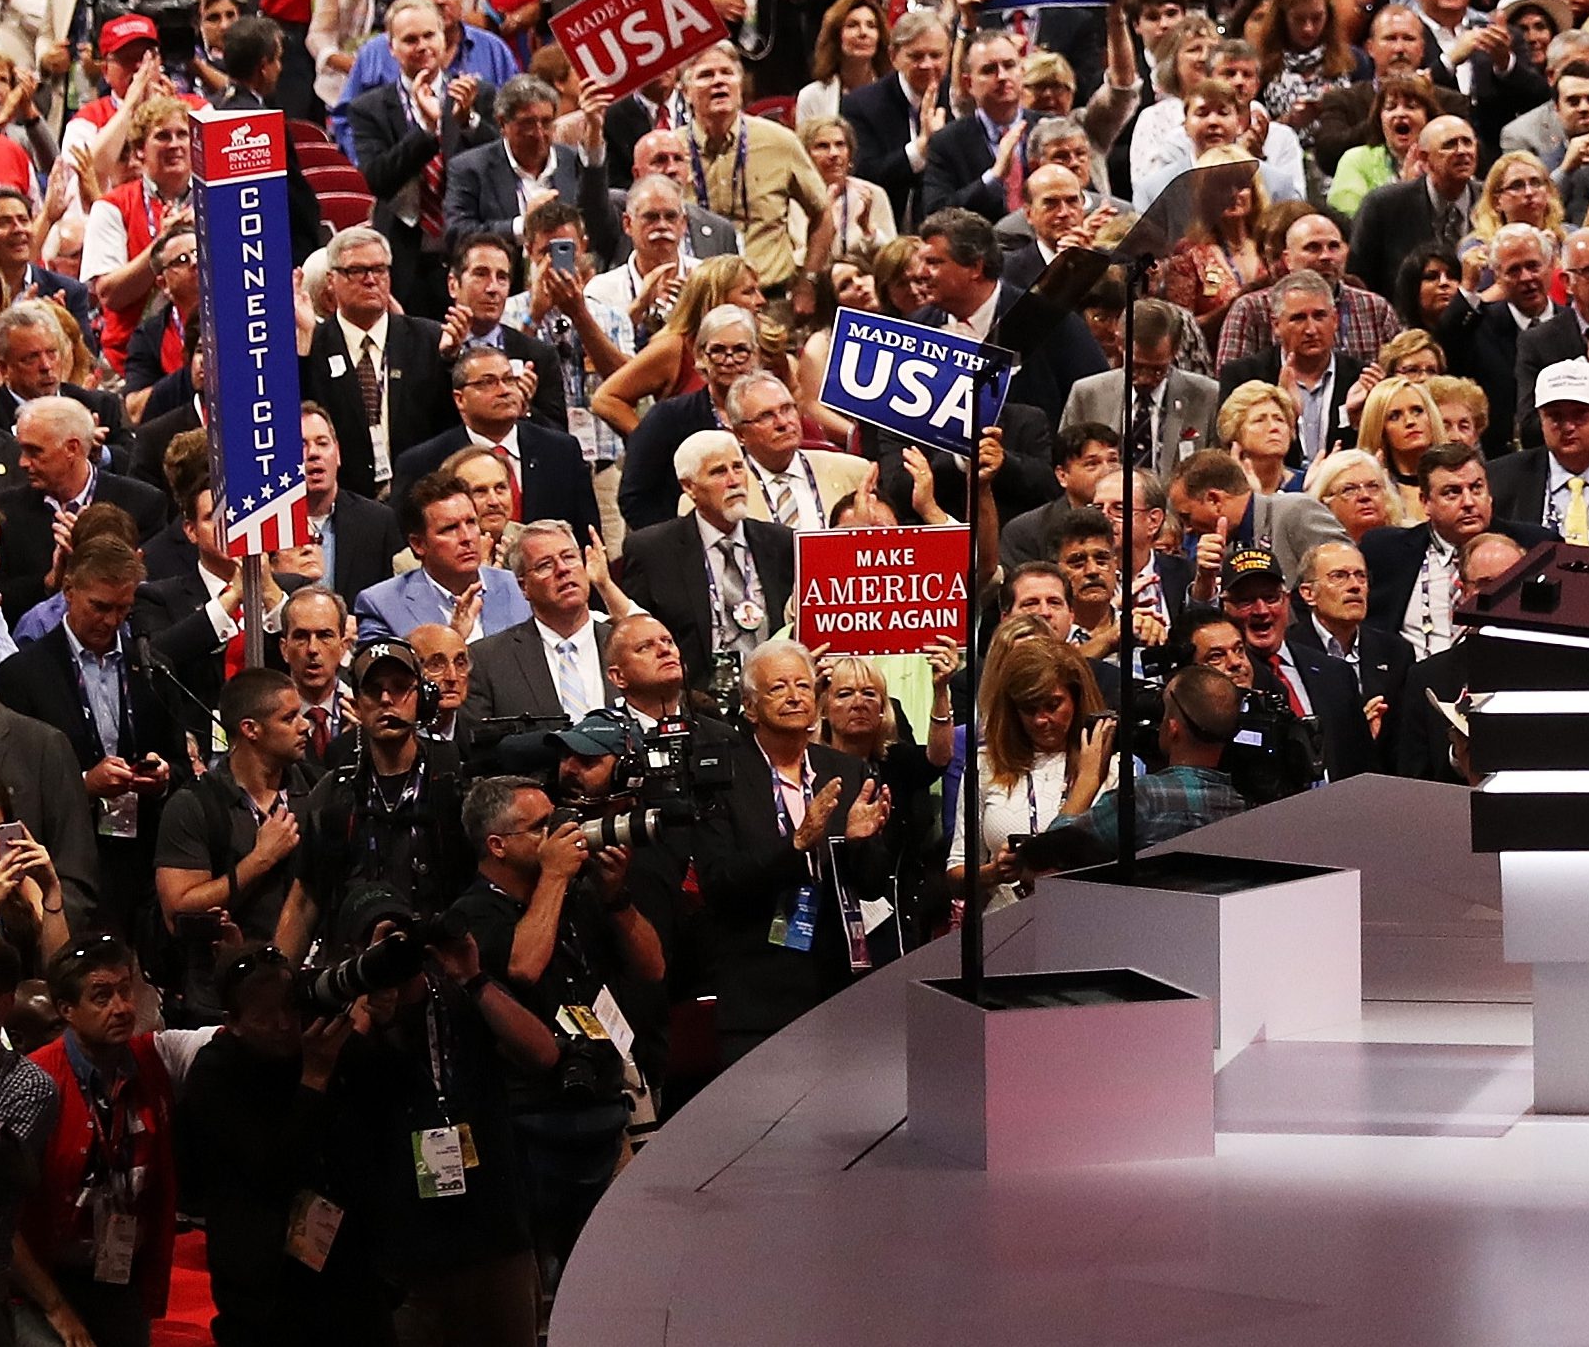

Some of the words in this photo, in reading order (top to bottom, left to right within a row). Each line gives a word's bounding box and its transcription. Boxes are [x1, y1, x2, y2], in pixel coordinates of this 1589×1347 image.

[565, 0, 620, 43] MADE
[229, 158, 271, 171] CLEVELAND
[239, 186, 276, 476] CONNECTICUT
[846, 322, 918, 353] MADE
[919, 340, 950, 362] IN
[952, 349, 990, 372] TH
[839, 340, 974, 440] USA
[856, 548, 915, 568] MAKE
[1230, 550, 1272, 567] VIETNAM
[801, 571, 968, 607] AMERICA
[815, 610, 883, 633] WORK
[888, 607, 958, 631] AGAIN
